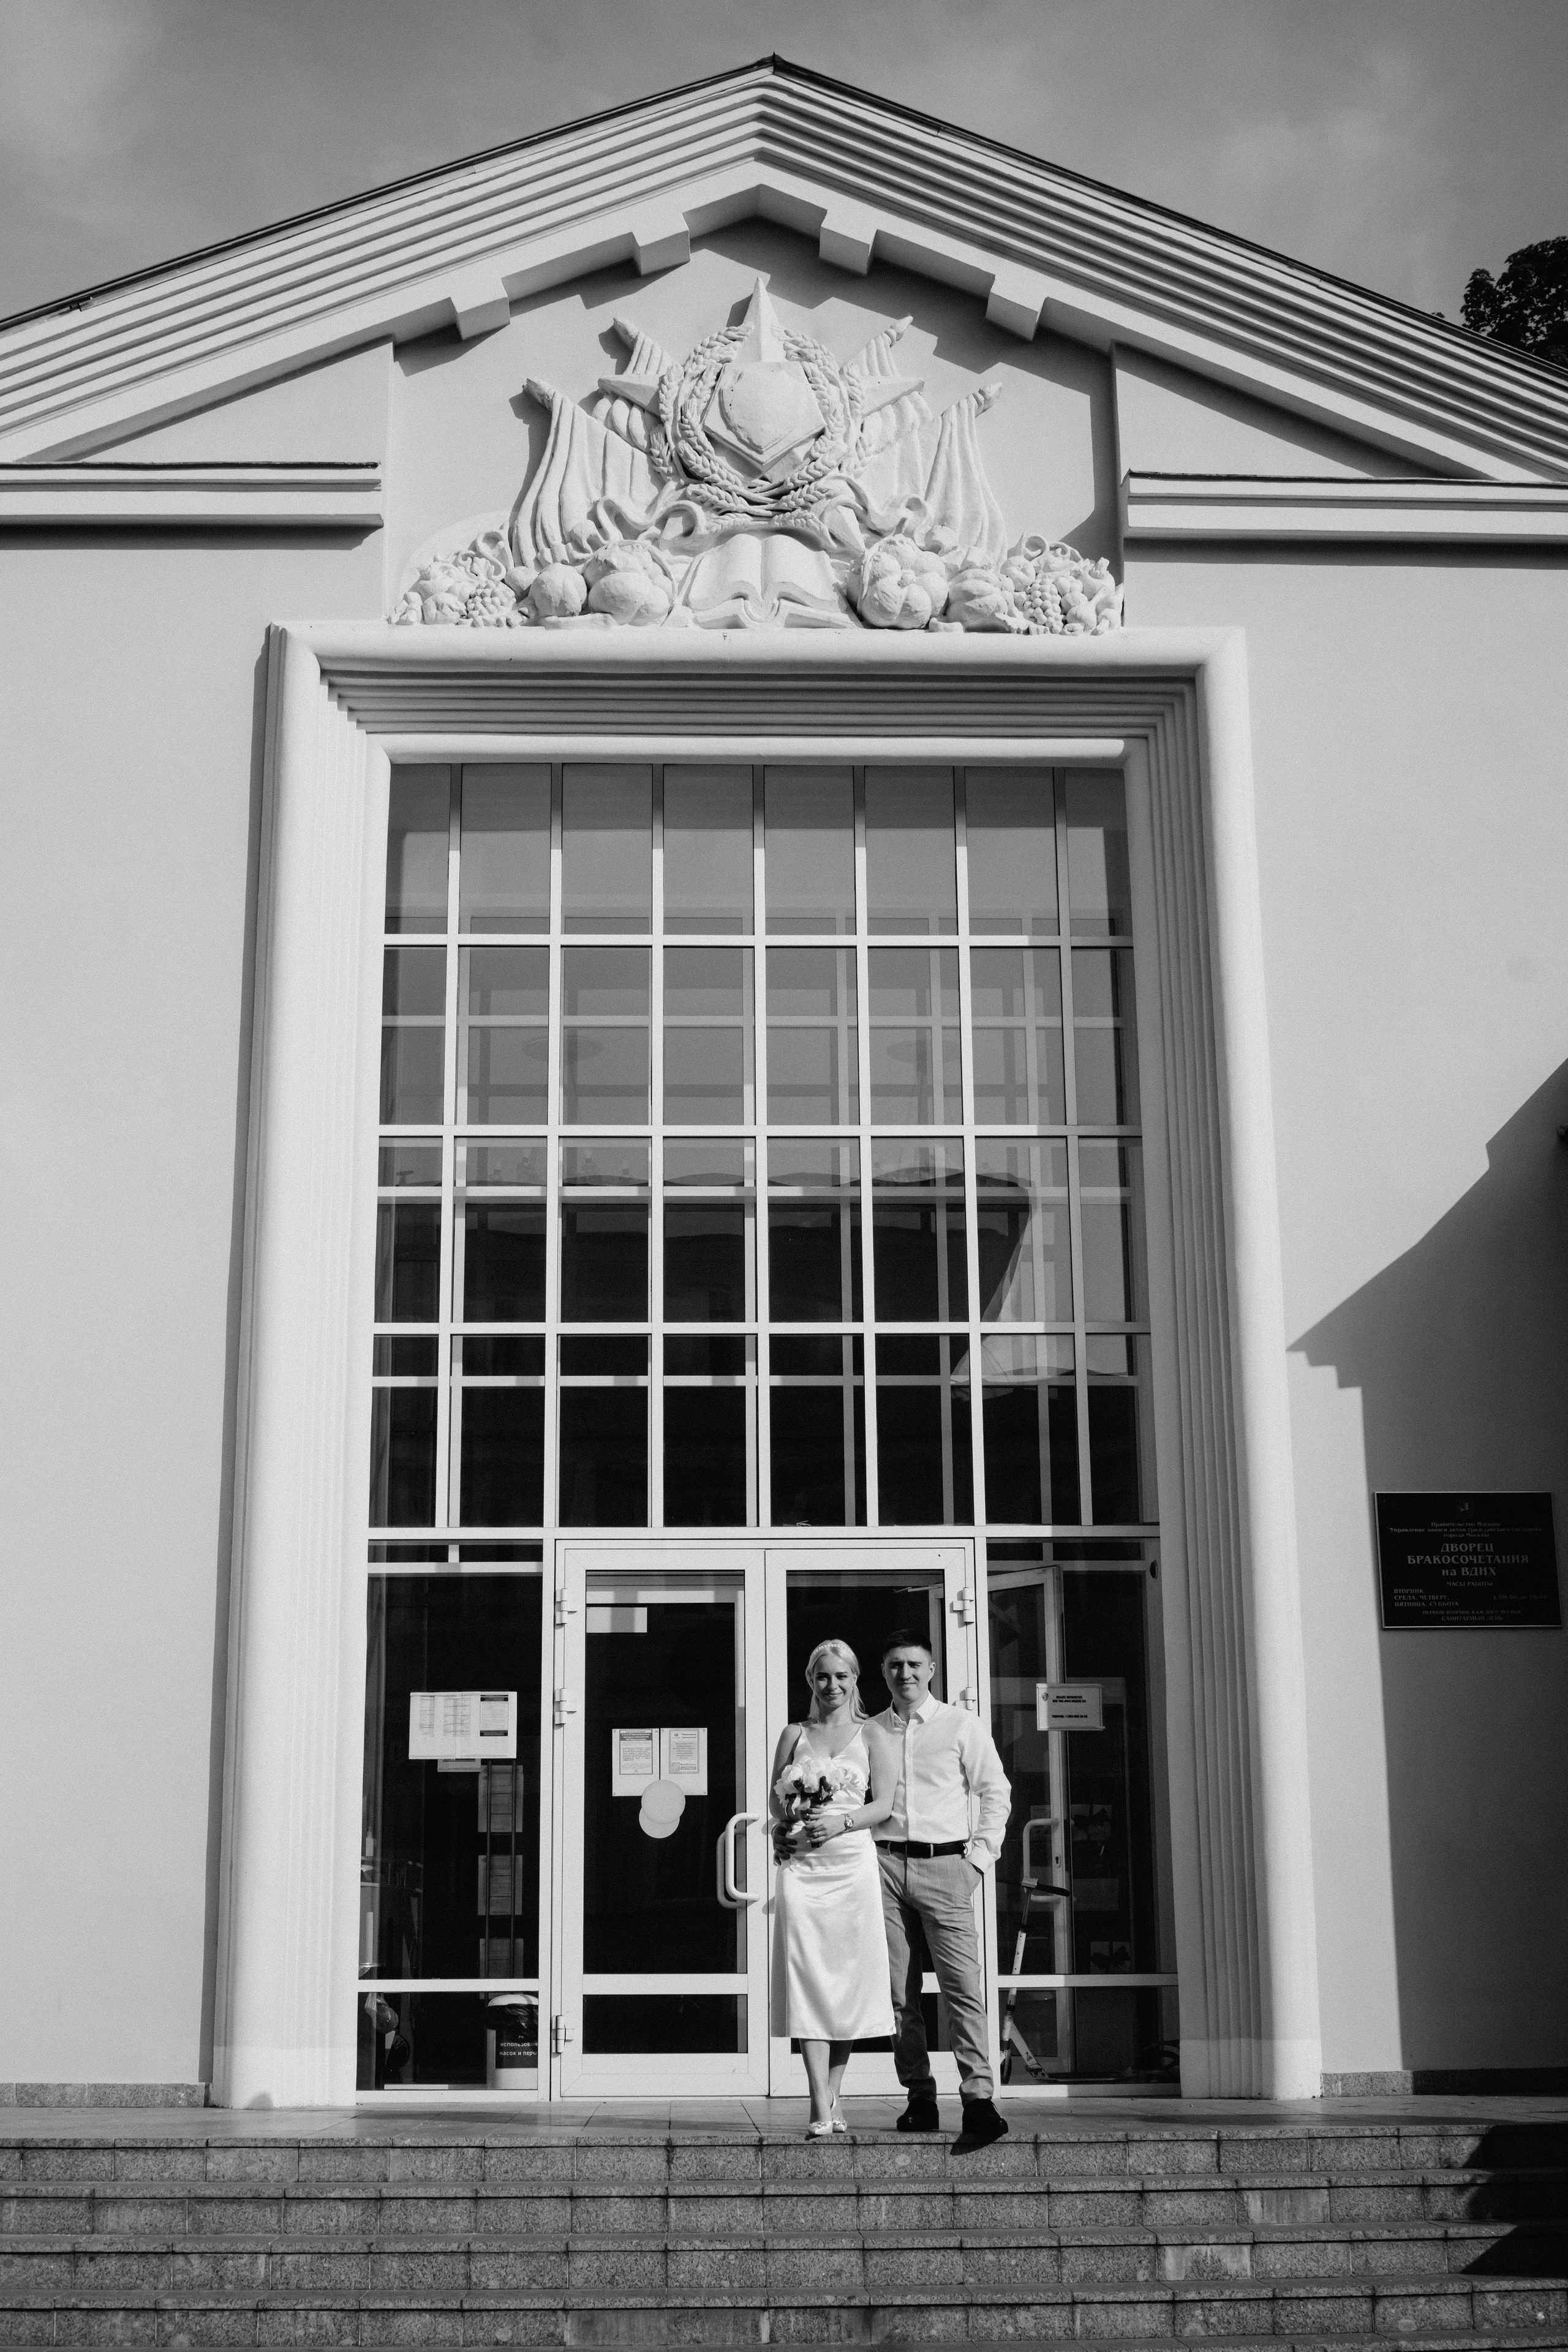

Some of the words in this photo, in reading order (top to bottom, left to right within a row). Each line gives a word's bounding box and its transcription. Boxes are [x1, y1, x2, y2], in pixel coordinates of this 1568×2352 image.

[1441, 1543, 1494, 1553] ДВОРЕЦ
[1407, 1555, 1529, 1564] БРАКОСОЧЕТАНИЯ
[1461, 1566, 1497, 1577] ВДНХ
